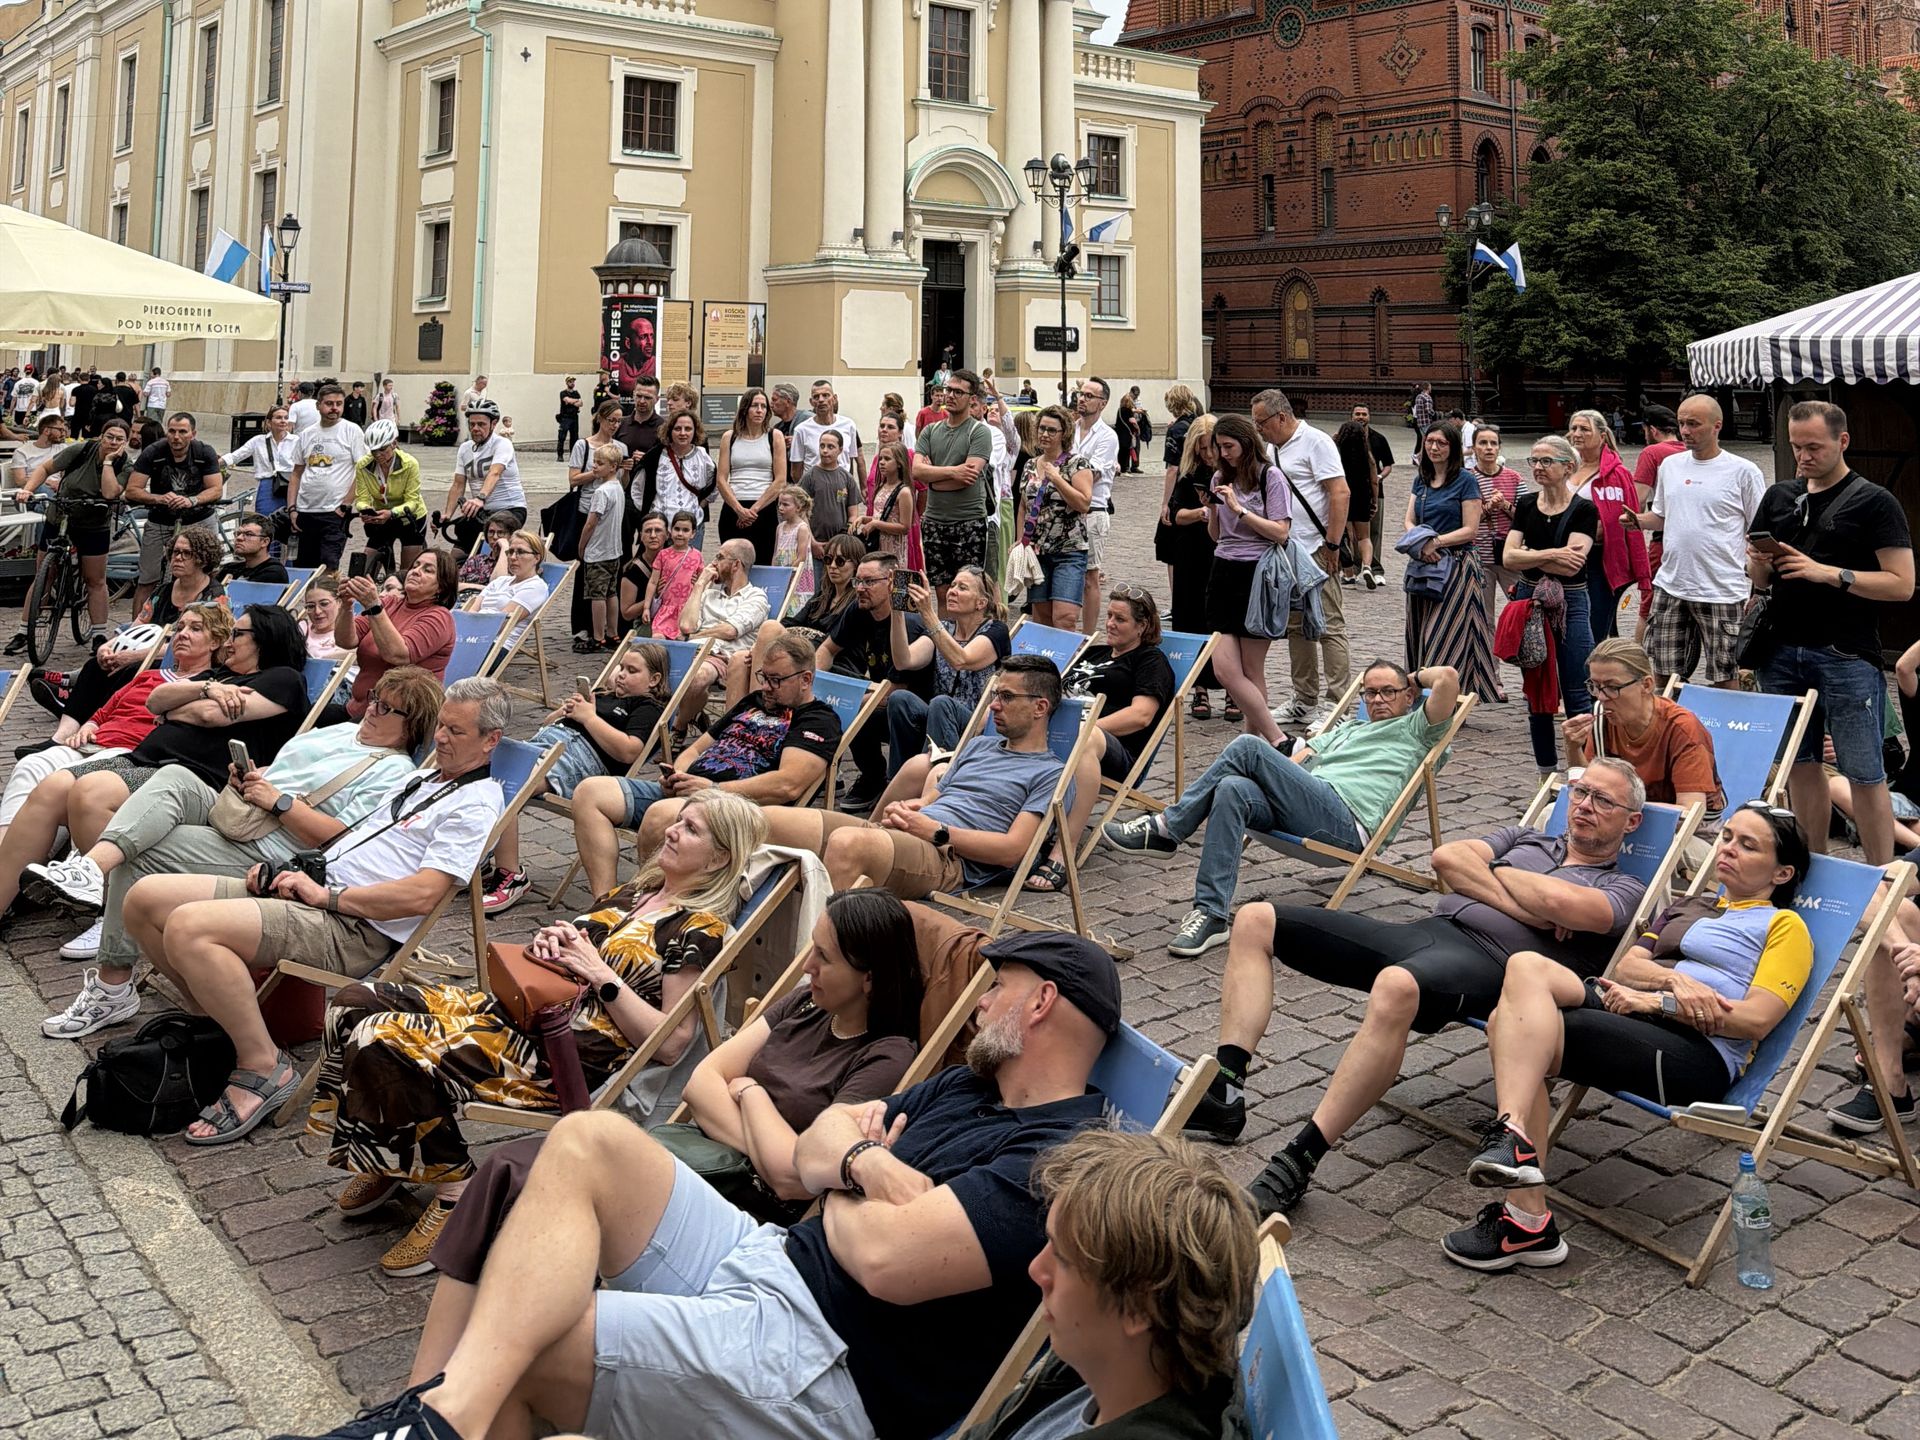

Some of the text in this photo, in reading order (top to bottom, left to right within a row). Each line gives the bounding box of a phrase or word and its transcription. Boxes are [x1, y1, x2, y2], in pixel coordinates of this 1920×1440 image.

[143, 305, 212, 317] PIEROGARNIA
[118, 319, 241, 334] POD BLASZANYM KOTEM
